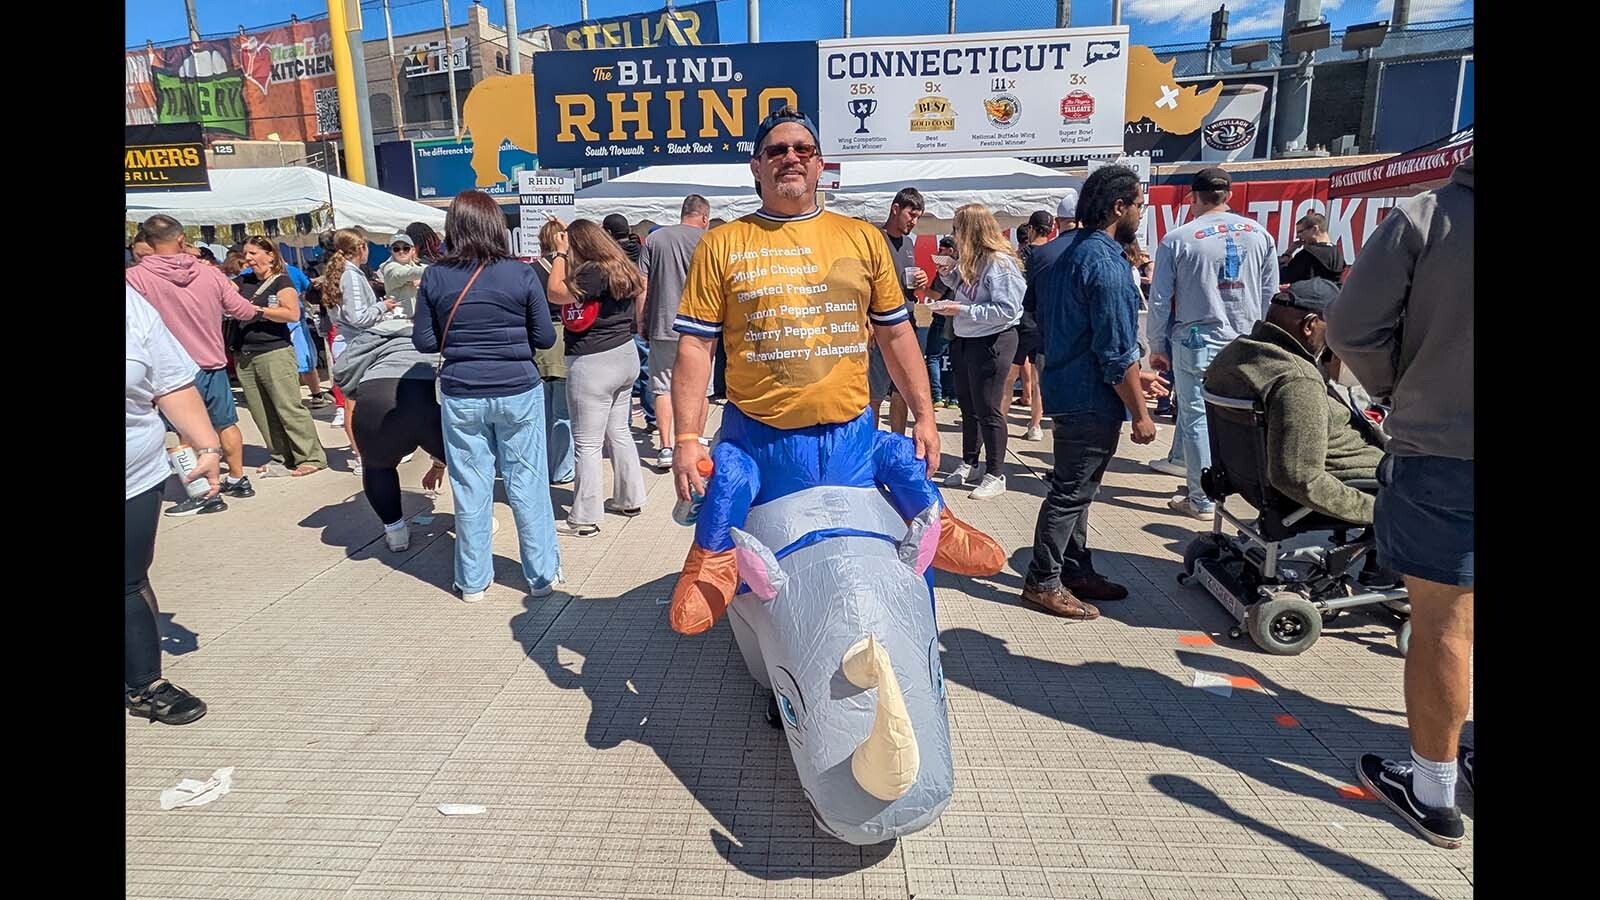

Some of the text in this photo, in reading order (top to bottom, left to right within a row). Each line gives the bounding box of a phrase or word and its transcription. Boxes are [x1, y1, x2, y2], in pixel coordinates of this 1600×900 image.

[566, 10, 701, 49] STELLAR
[271, 55, 336, 81] KITCHEN
[827, 43, 1071, 80] CONNECTICUT
[592, 66, 614, 82] The
[1070, 73, 1087, 85] 3x
[850, 83, 875, 96] 35x
[925, 81, 941, 93] 9x
[418, 148, 431, 157] The
[431, 147, 464, 157] difference
[585, 145, 608, 157] South
[609, 144, 645, 156] Norwalk
[667, 143, 692, 154] Black
[692, 142, 713, 153] Rock
[1373, 166, 1385, 180] ST
[528, 177, 565, 186] RHINO
[521, 195, 573, 204] WING MENU!
[760, 245, 812, 257] Sriracha
[770, 264, 819, 276] Chipotle
[737, 283, 828, 303] Roasted Fresno
[567, 309, 585, 320] NY
[780, 303, 823, 318] Pepper
[825, 300, 858, 312] Ranch
[744, 328, 781, 343] Cherry
[784, 324, 828, 339] Pepper
[745, 347, 813, 363] Strawberry
